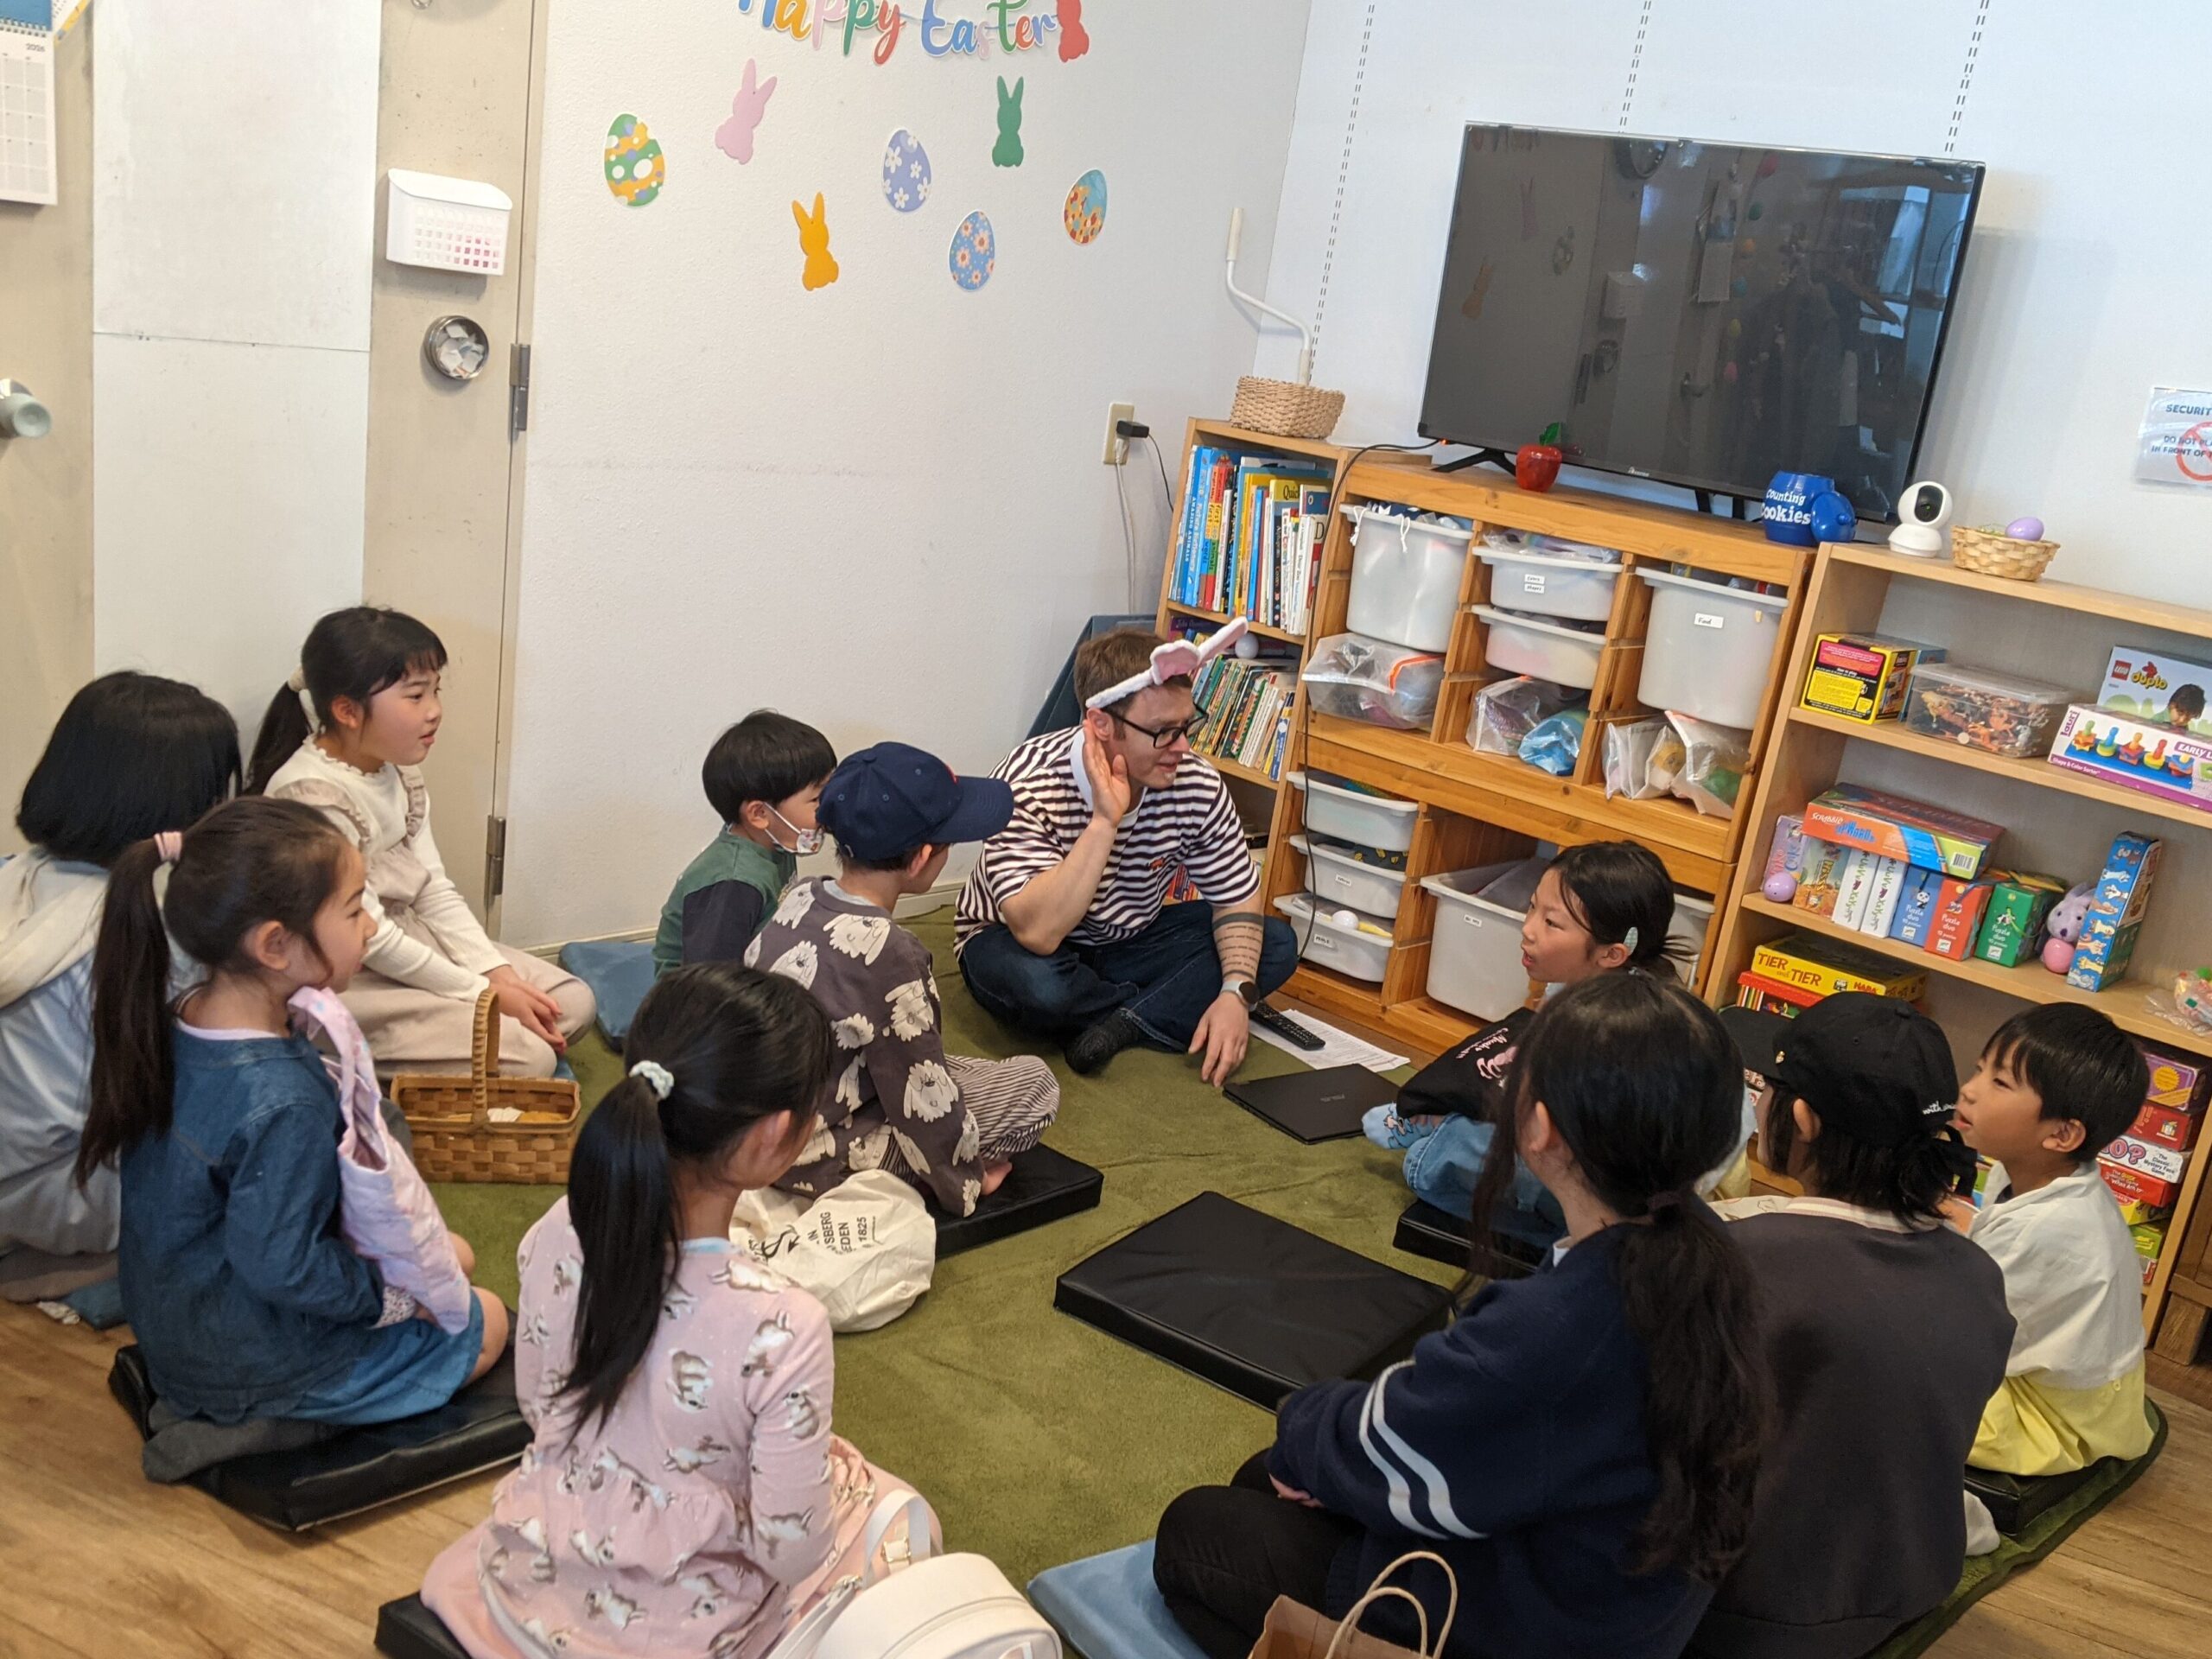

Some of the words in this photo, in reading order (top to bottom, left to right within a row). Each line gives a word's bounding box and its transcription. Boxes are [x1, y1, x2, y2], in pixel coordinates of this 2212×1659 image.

[920, 0, 1058, 60] Easter
[2164, 447, 2191, 455] FRONT
[1283, 485, 1300, 501] Quic
[2132, 671, 2168, 690] duplo
[2178, 745, 2208, 759] EARLY
[1906, 905, 1924, 916] Puzzle
[1942, 913, 1961, 925] Puzzle
[1942, 923, 1955, 931] duo
[1992, 925, 2011, 937] Puzzle
[1993, 933, 2006, 942] duo
[1758, 952, 1789, 970] TIER
[1791, 968, 1822, 987] TIER
[2101, 1137, 2147, 1165] O?
[2152, 1157, 2170, 1166] Classic
[820, 1211, 835, 1245] SBERG
[856, 1217, 868, 1243] 1825
[837, 1222, 853, 1253] EDEN
